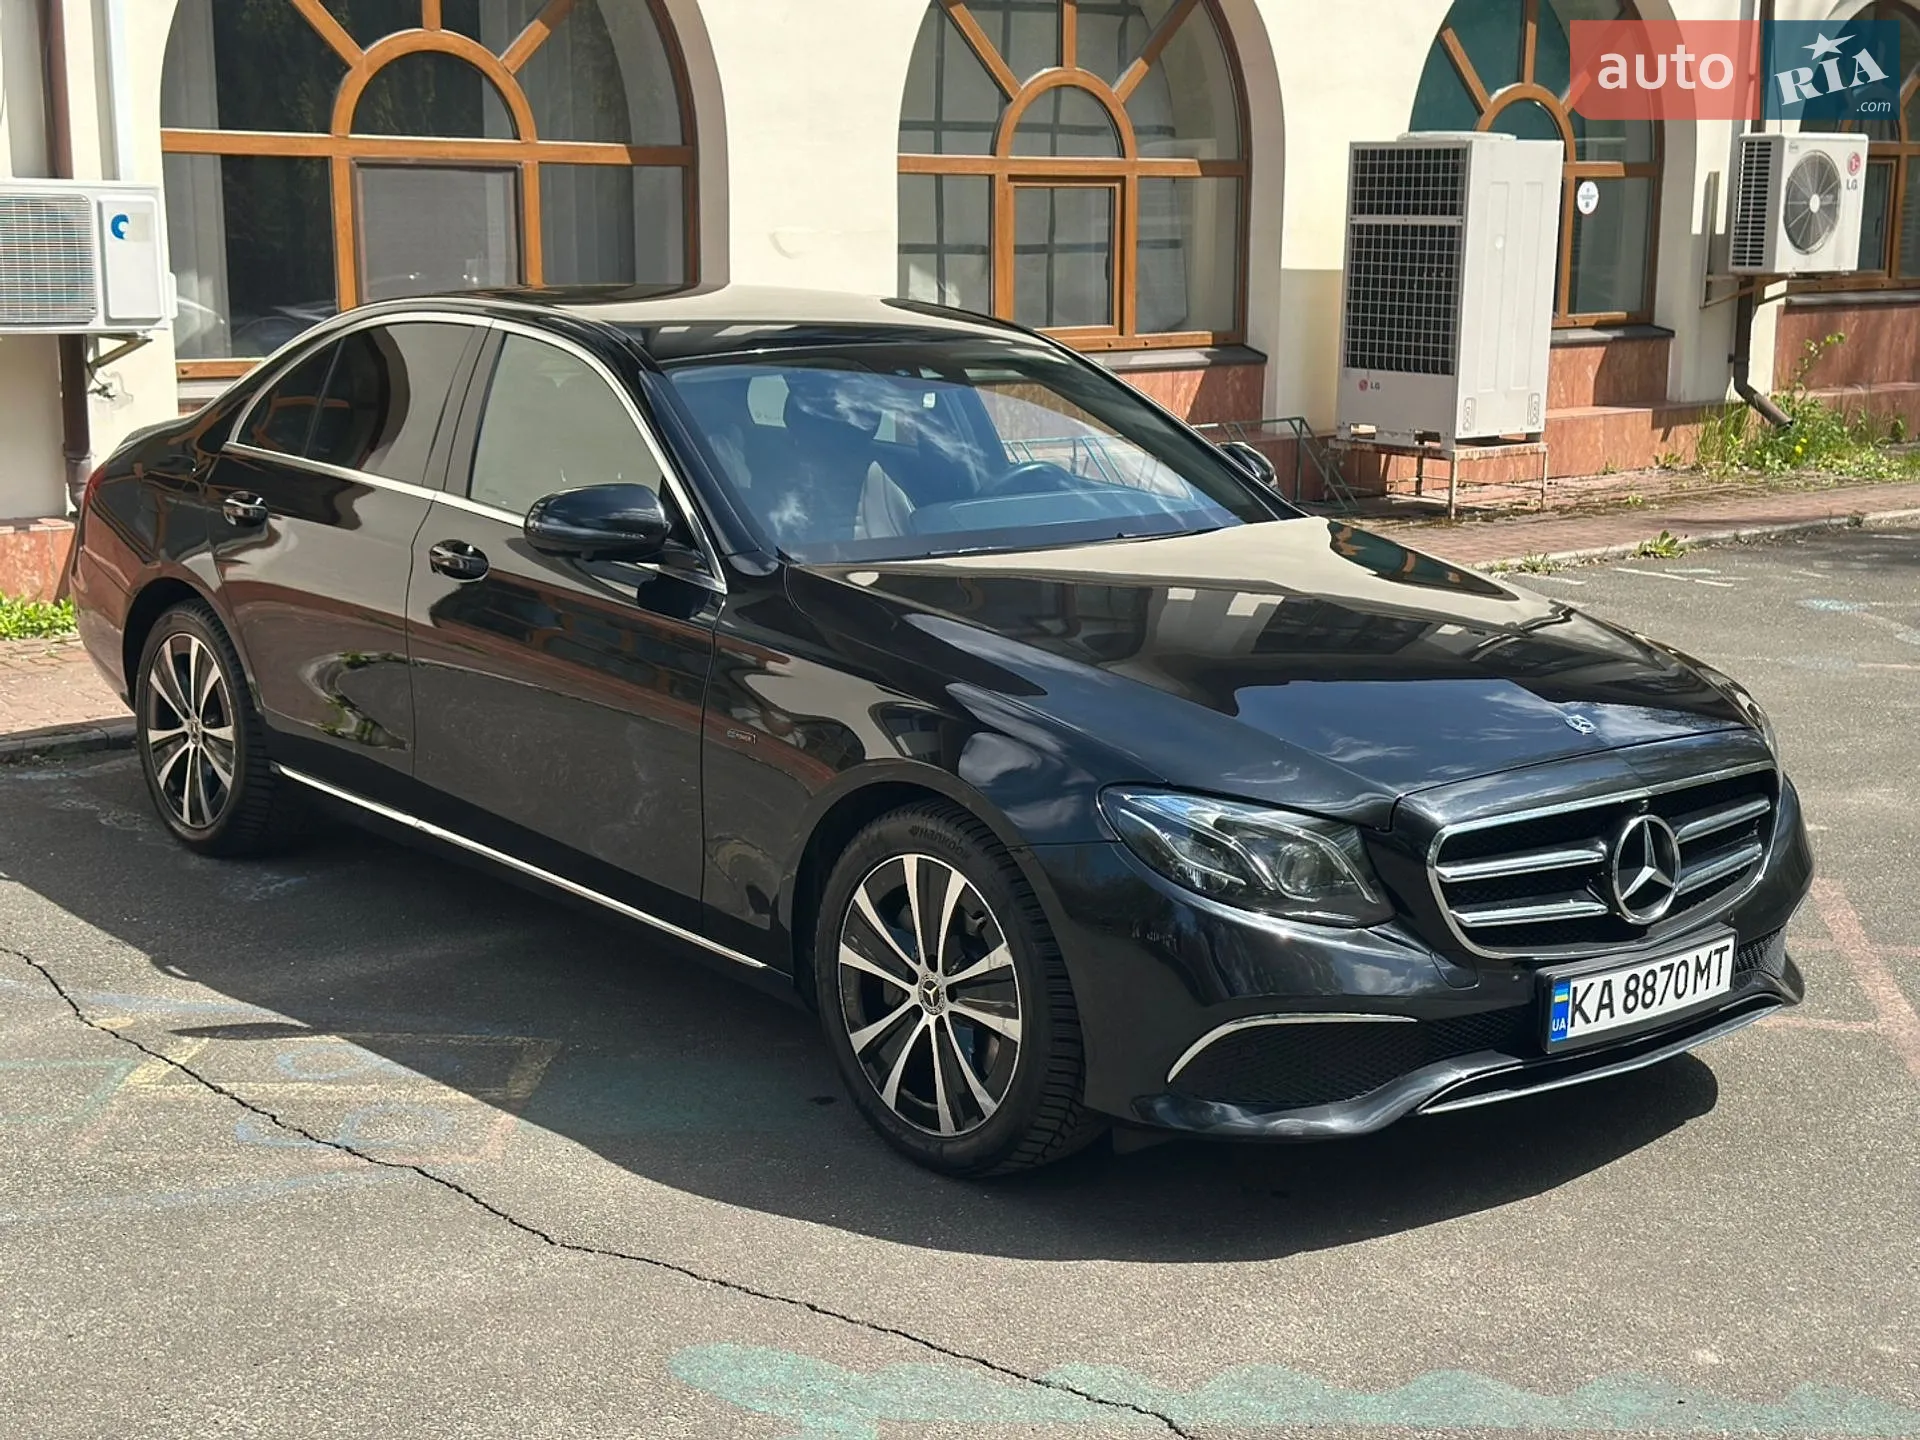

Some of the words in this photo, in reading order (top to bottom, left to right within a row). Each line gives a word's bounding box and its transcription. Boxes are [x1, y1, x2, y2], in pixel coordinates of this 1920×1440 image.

[1846, 179, 1858, 190] LG
[1370, 381, 1380, 390] LG
[1570, 979, 1614, 1027] KA
[1623, 960, 1689, 1014] 8870
[1693, 945, 1729, 994] MT
[1552, 1018, 1566, 1031] UA
